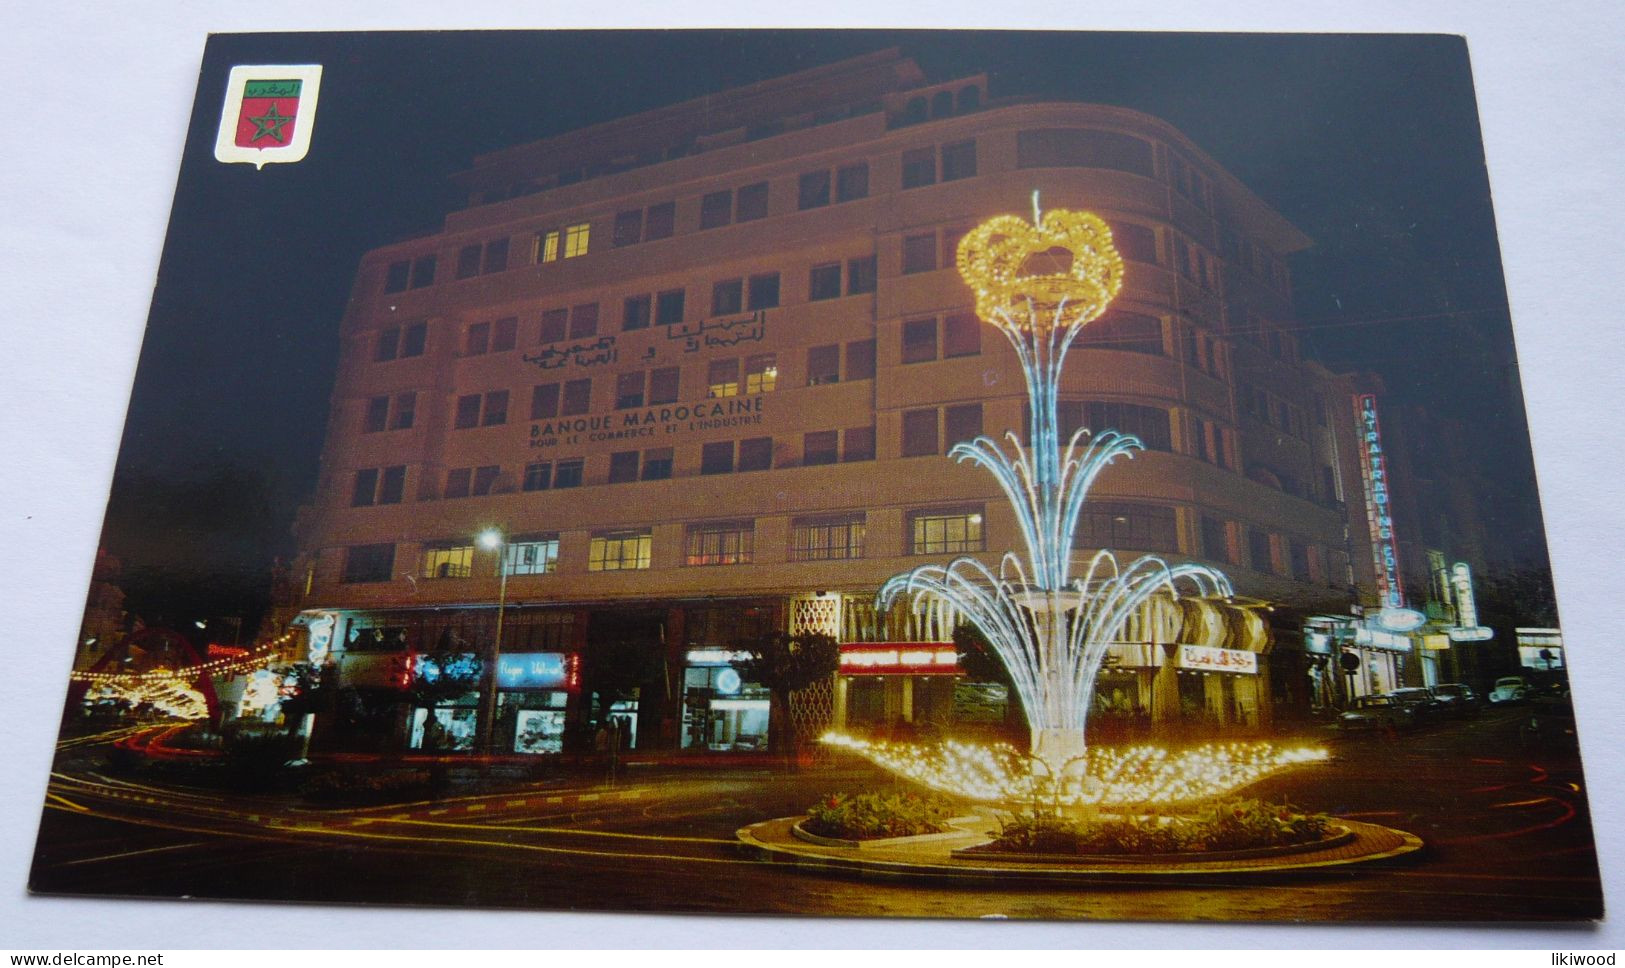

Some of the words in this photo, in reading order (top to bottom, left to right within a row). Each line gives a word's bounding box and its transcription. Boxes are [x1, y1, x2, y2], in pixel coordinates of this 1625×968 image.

[248, 83, 300, 97] المغرب
[530, 415, 612, 438] BANQUE
[623, 397, 763, 427] MAROCAINE
[589, 426, 656, 442] COMMERCE
[666, 423, 678, 434] ET
